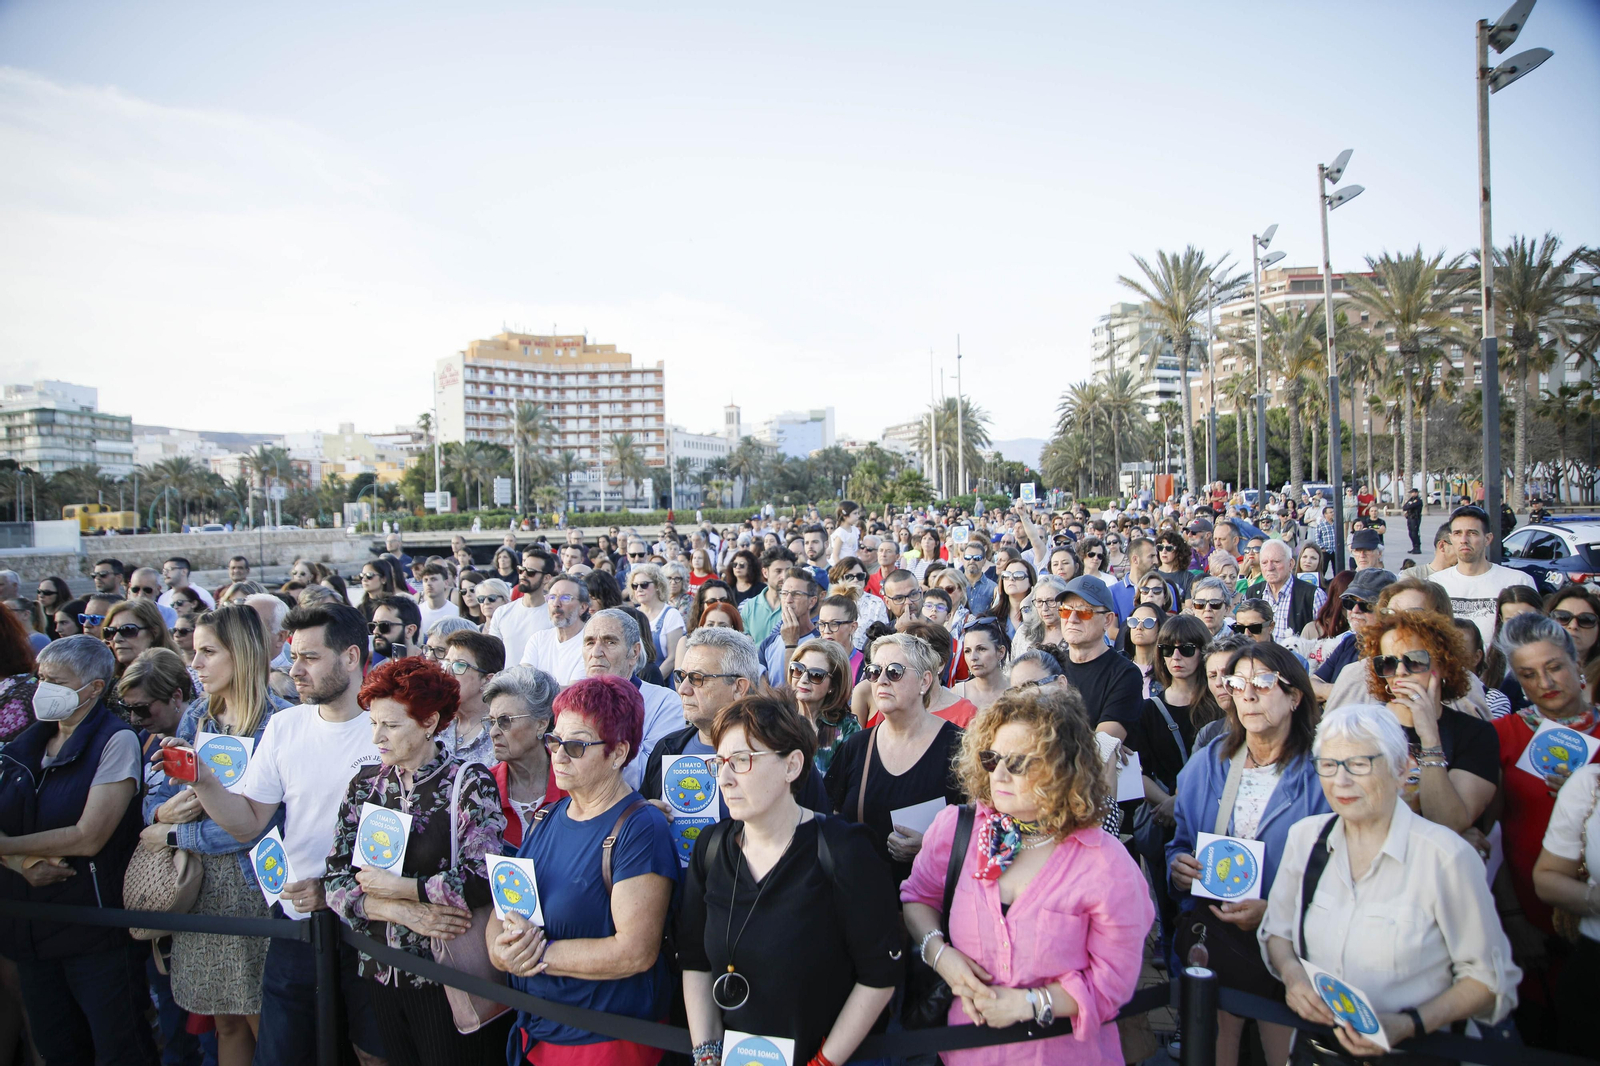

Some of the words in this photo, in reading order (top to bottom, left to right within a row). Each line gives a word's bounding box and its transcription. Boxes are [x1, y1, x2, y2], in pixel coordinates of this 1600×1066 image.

[1082, 581, 1102, 593] EA7
[350, 755, 372, 769] TOMMY
[369, 819, 384, 828] TODOS
[384, 824, 400, 833] SOMOS
[1206, 846, 1215, 866] SOMOS
[1204, 866, 1213, 885] TODOS
[737, 1047, 756, 1057] TODOS
[758, 1050, 779, 1061] SOMOS
